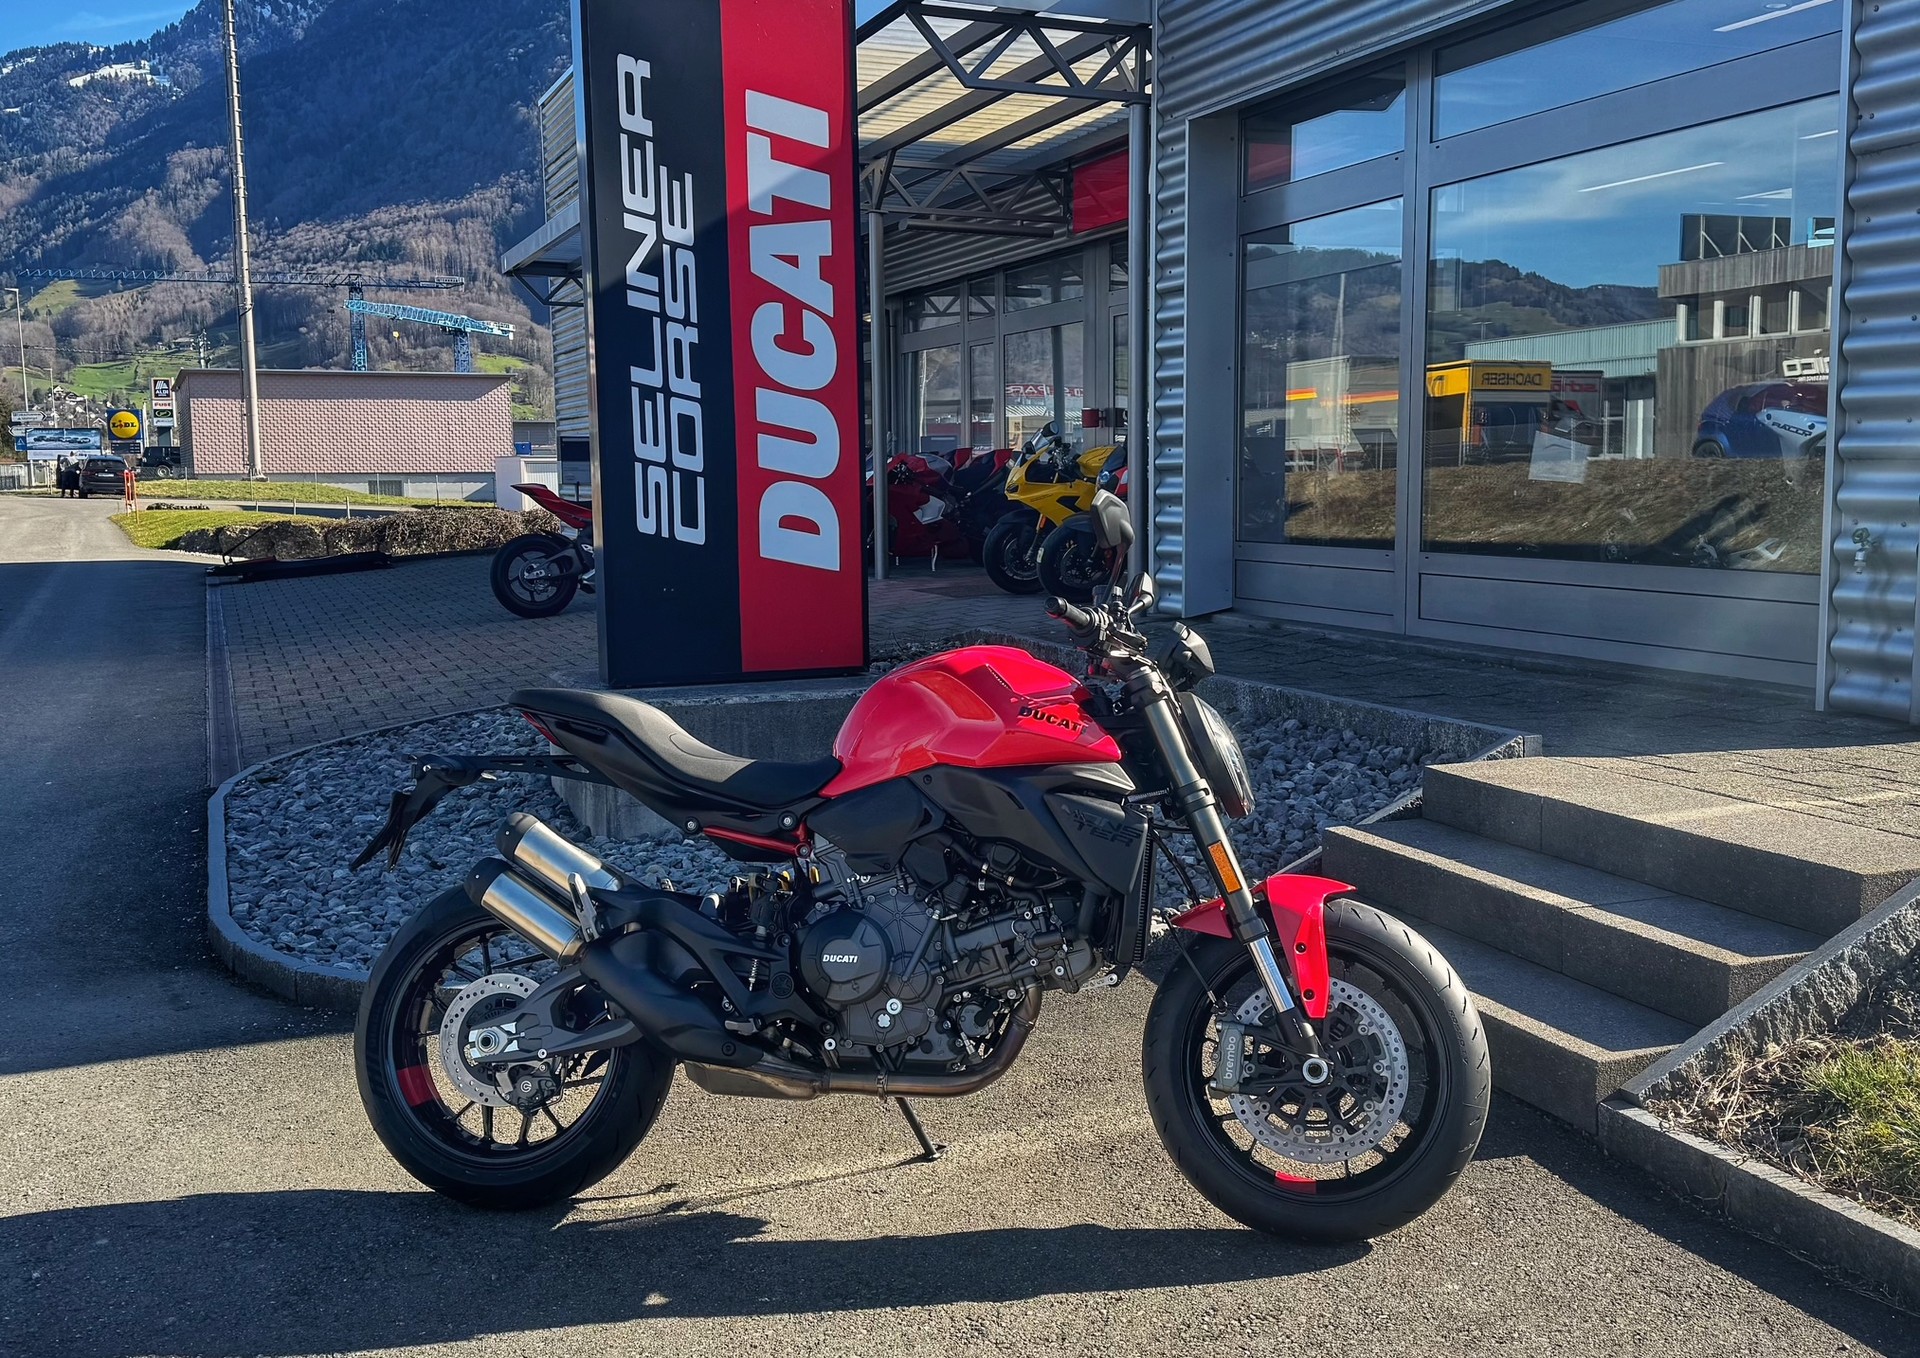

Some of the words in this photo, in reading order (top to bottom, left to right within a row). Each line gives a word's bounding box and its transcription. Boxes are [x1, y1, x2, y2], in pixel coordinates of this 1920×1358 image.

[617, 52, 669, 539] SELINER
[660, 163, 706, 546] CORSE
[745, 89, 841, 572] DUCATI
[1018, 706, 1088, 735] DUCATI
[822, 953, 858, 964] DUCATI
[1223, 1035, 1237, 1080] brembo
